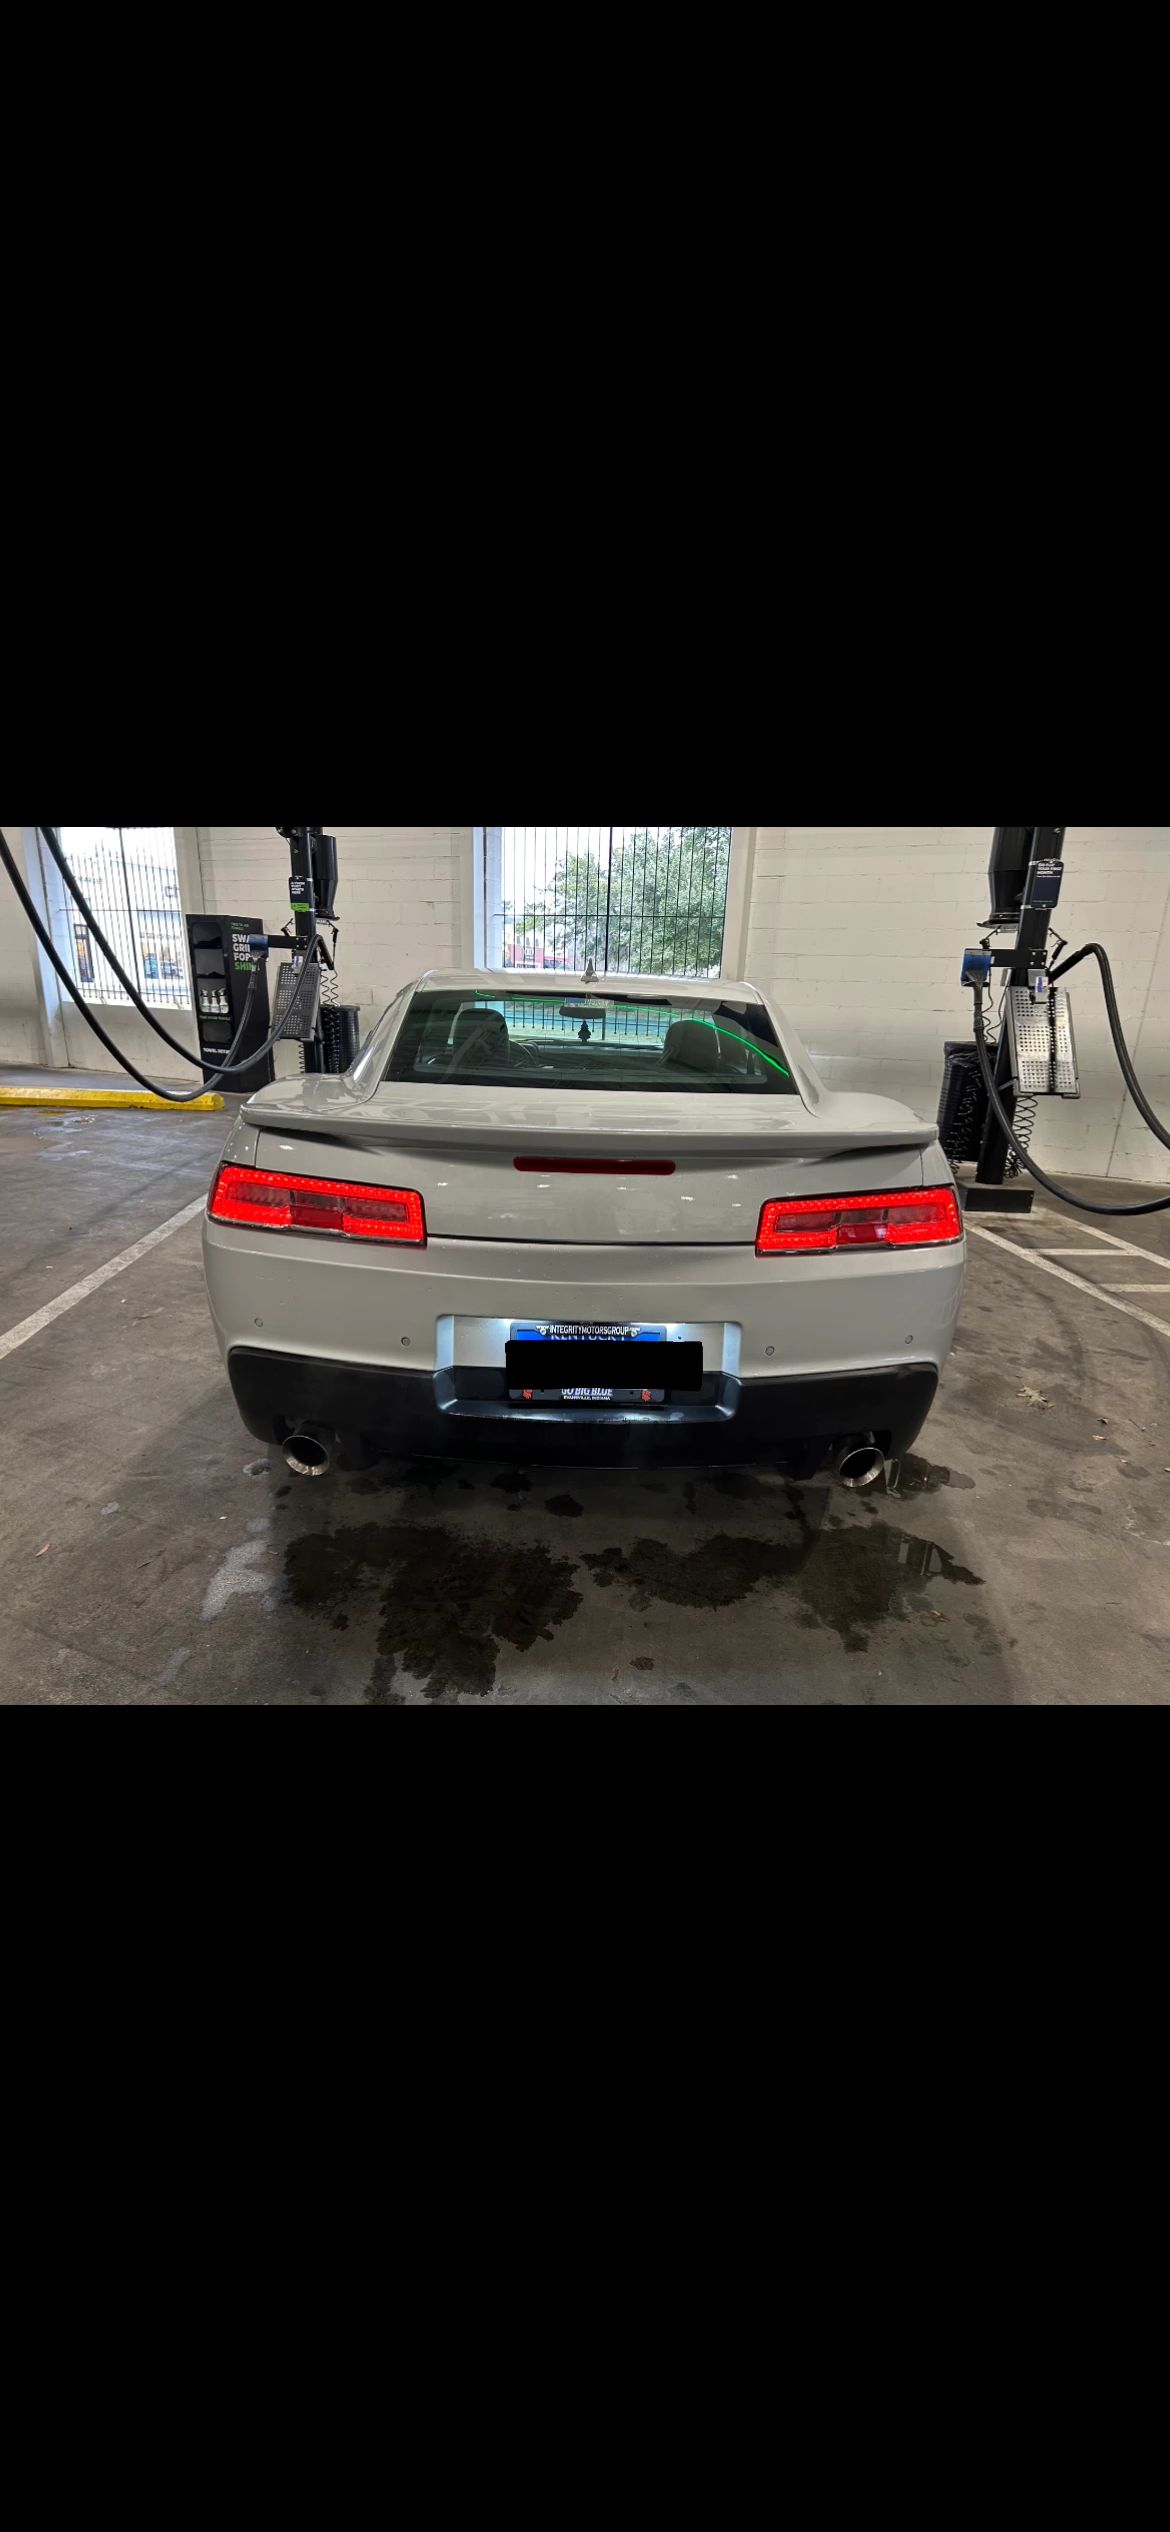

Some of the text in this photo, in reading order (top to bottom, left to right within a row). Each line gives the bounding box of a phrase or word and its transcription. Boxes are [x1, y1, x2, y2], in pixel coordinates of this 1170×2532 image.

[233, 943, 250, 952] GRI
[574, 1387, 591, 1396] BIG
[591, 1387, 613, 1397] BLUE
